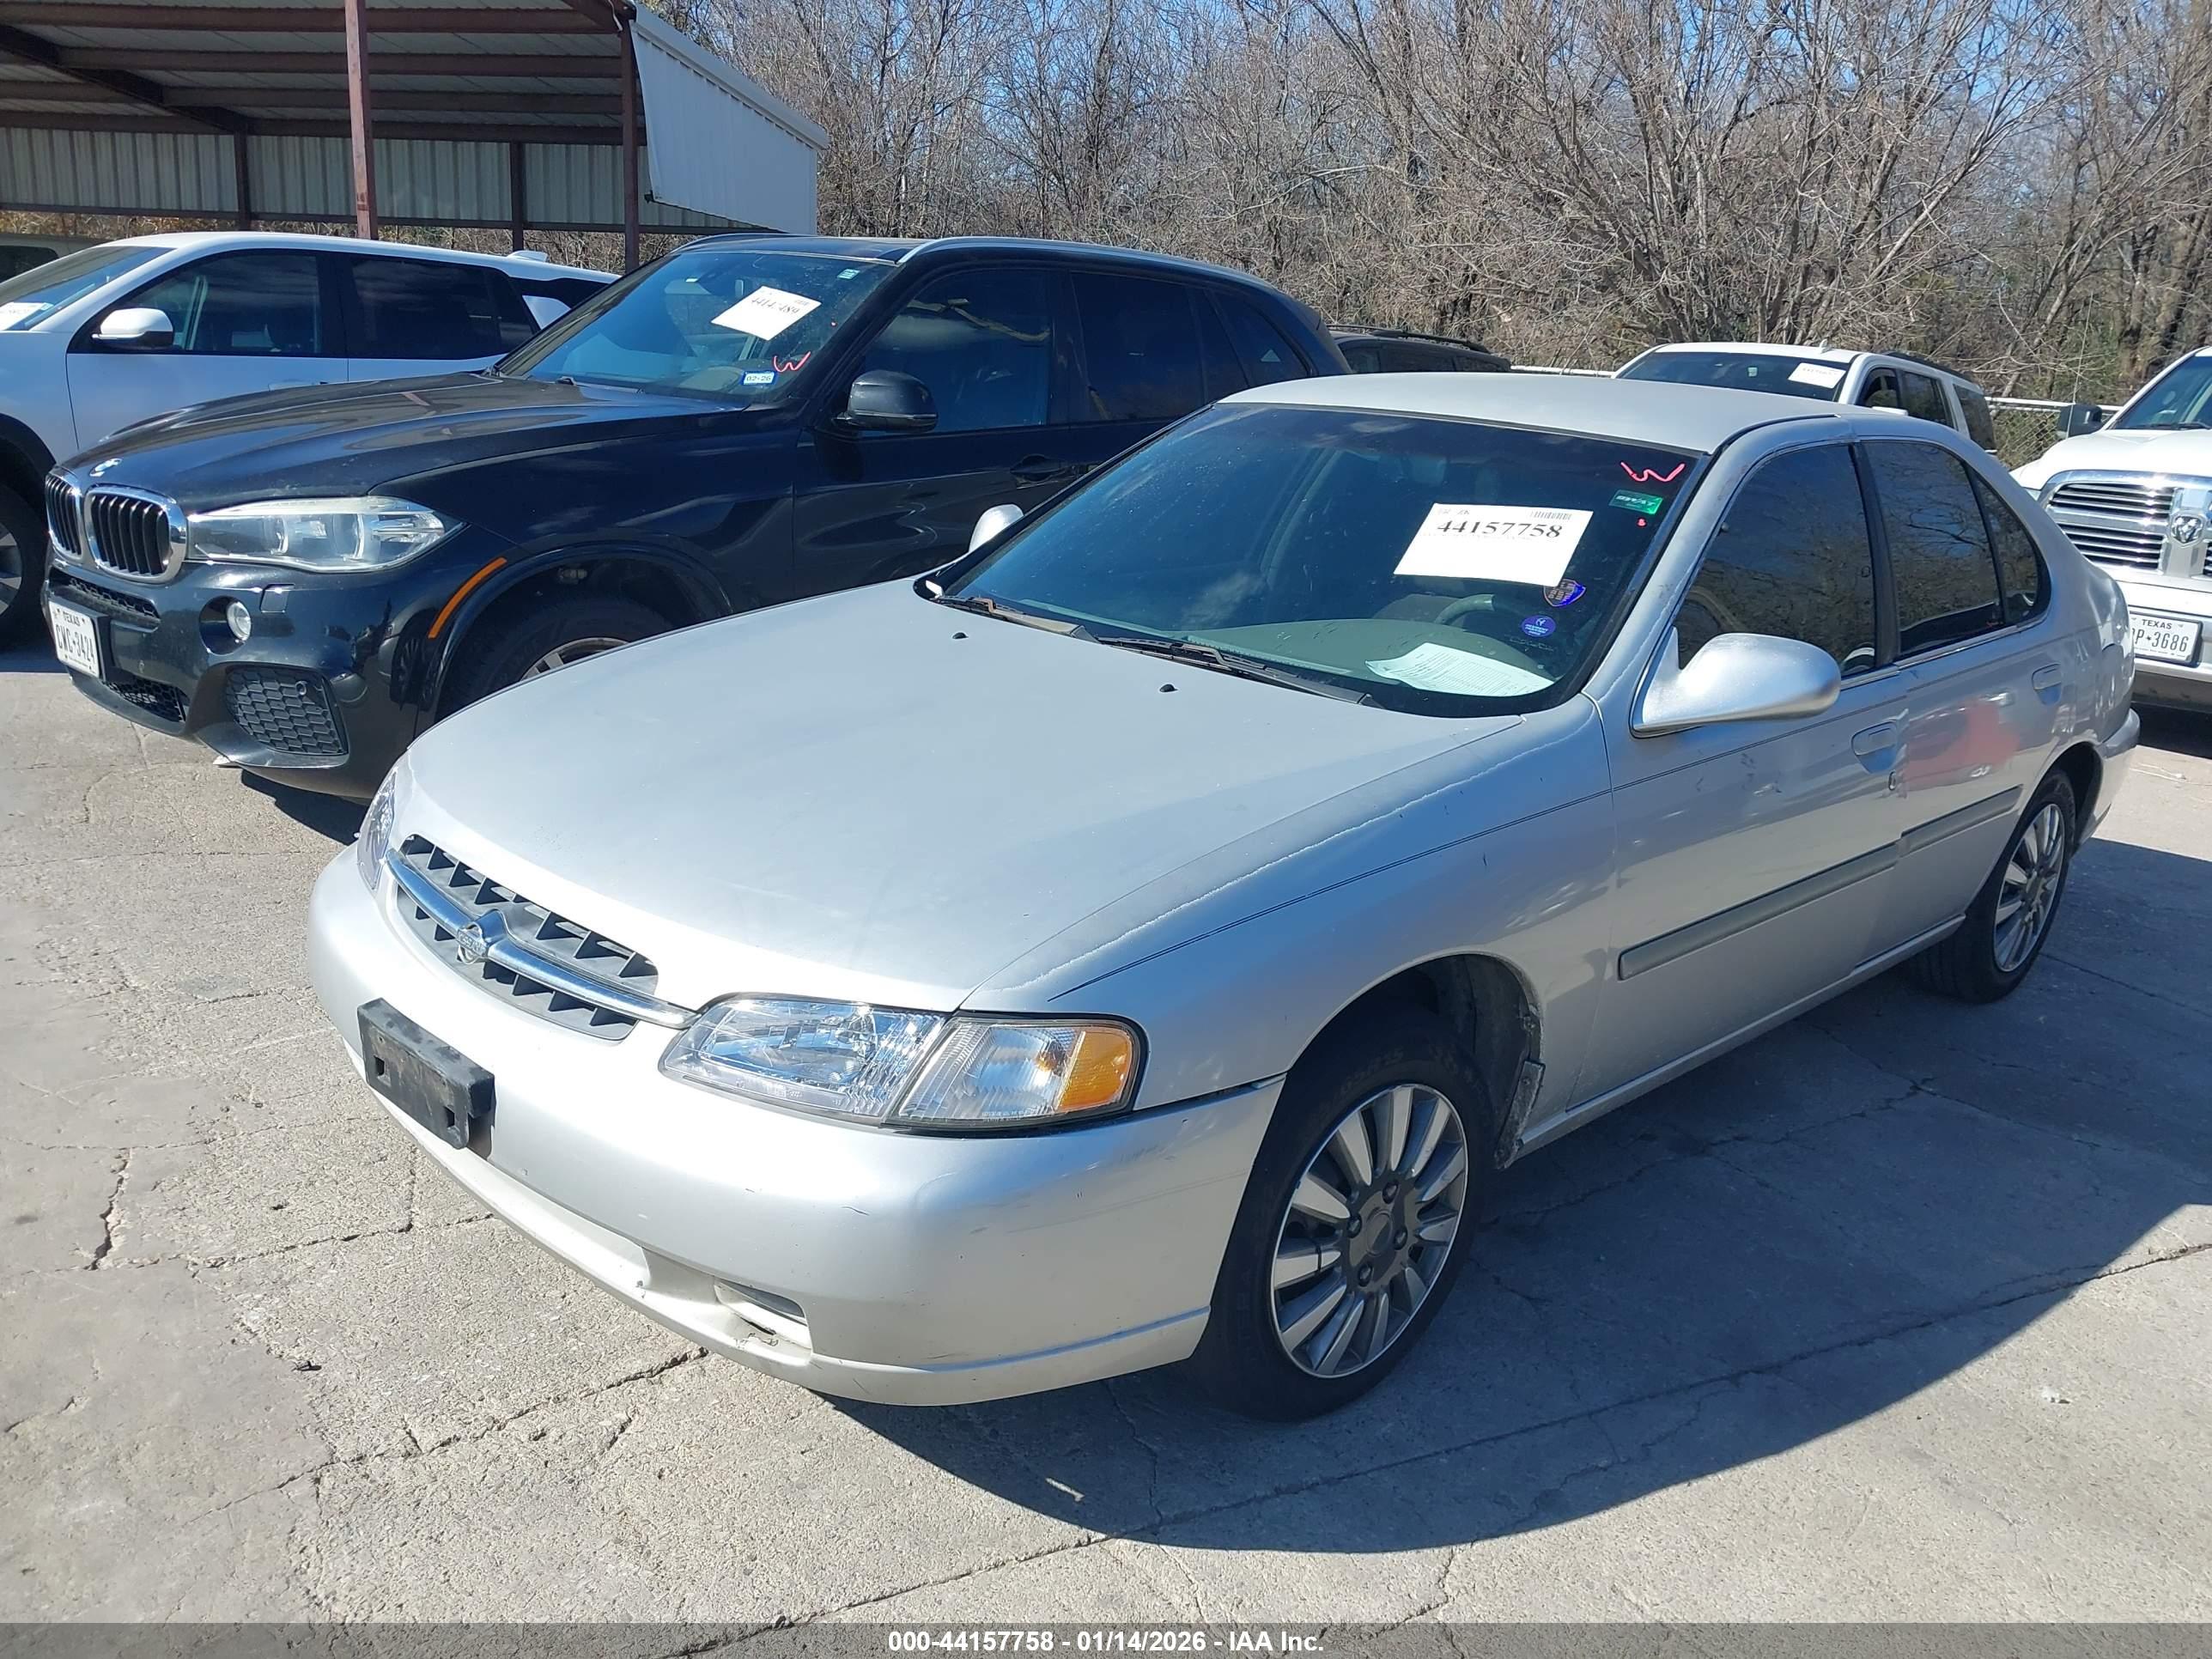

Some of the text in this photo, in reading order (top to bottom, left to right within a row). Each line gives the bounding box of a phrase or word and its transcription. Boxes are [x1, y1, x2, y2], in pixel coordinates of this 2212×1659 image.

[1437, 520, 1563, 538] 44157758
[63, 611, 81, 627] TEXAS
[2142, 618, 2172, 630] TEXAS
